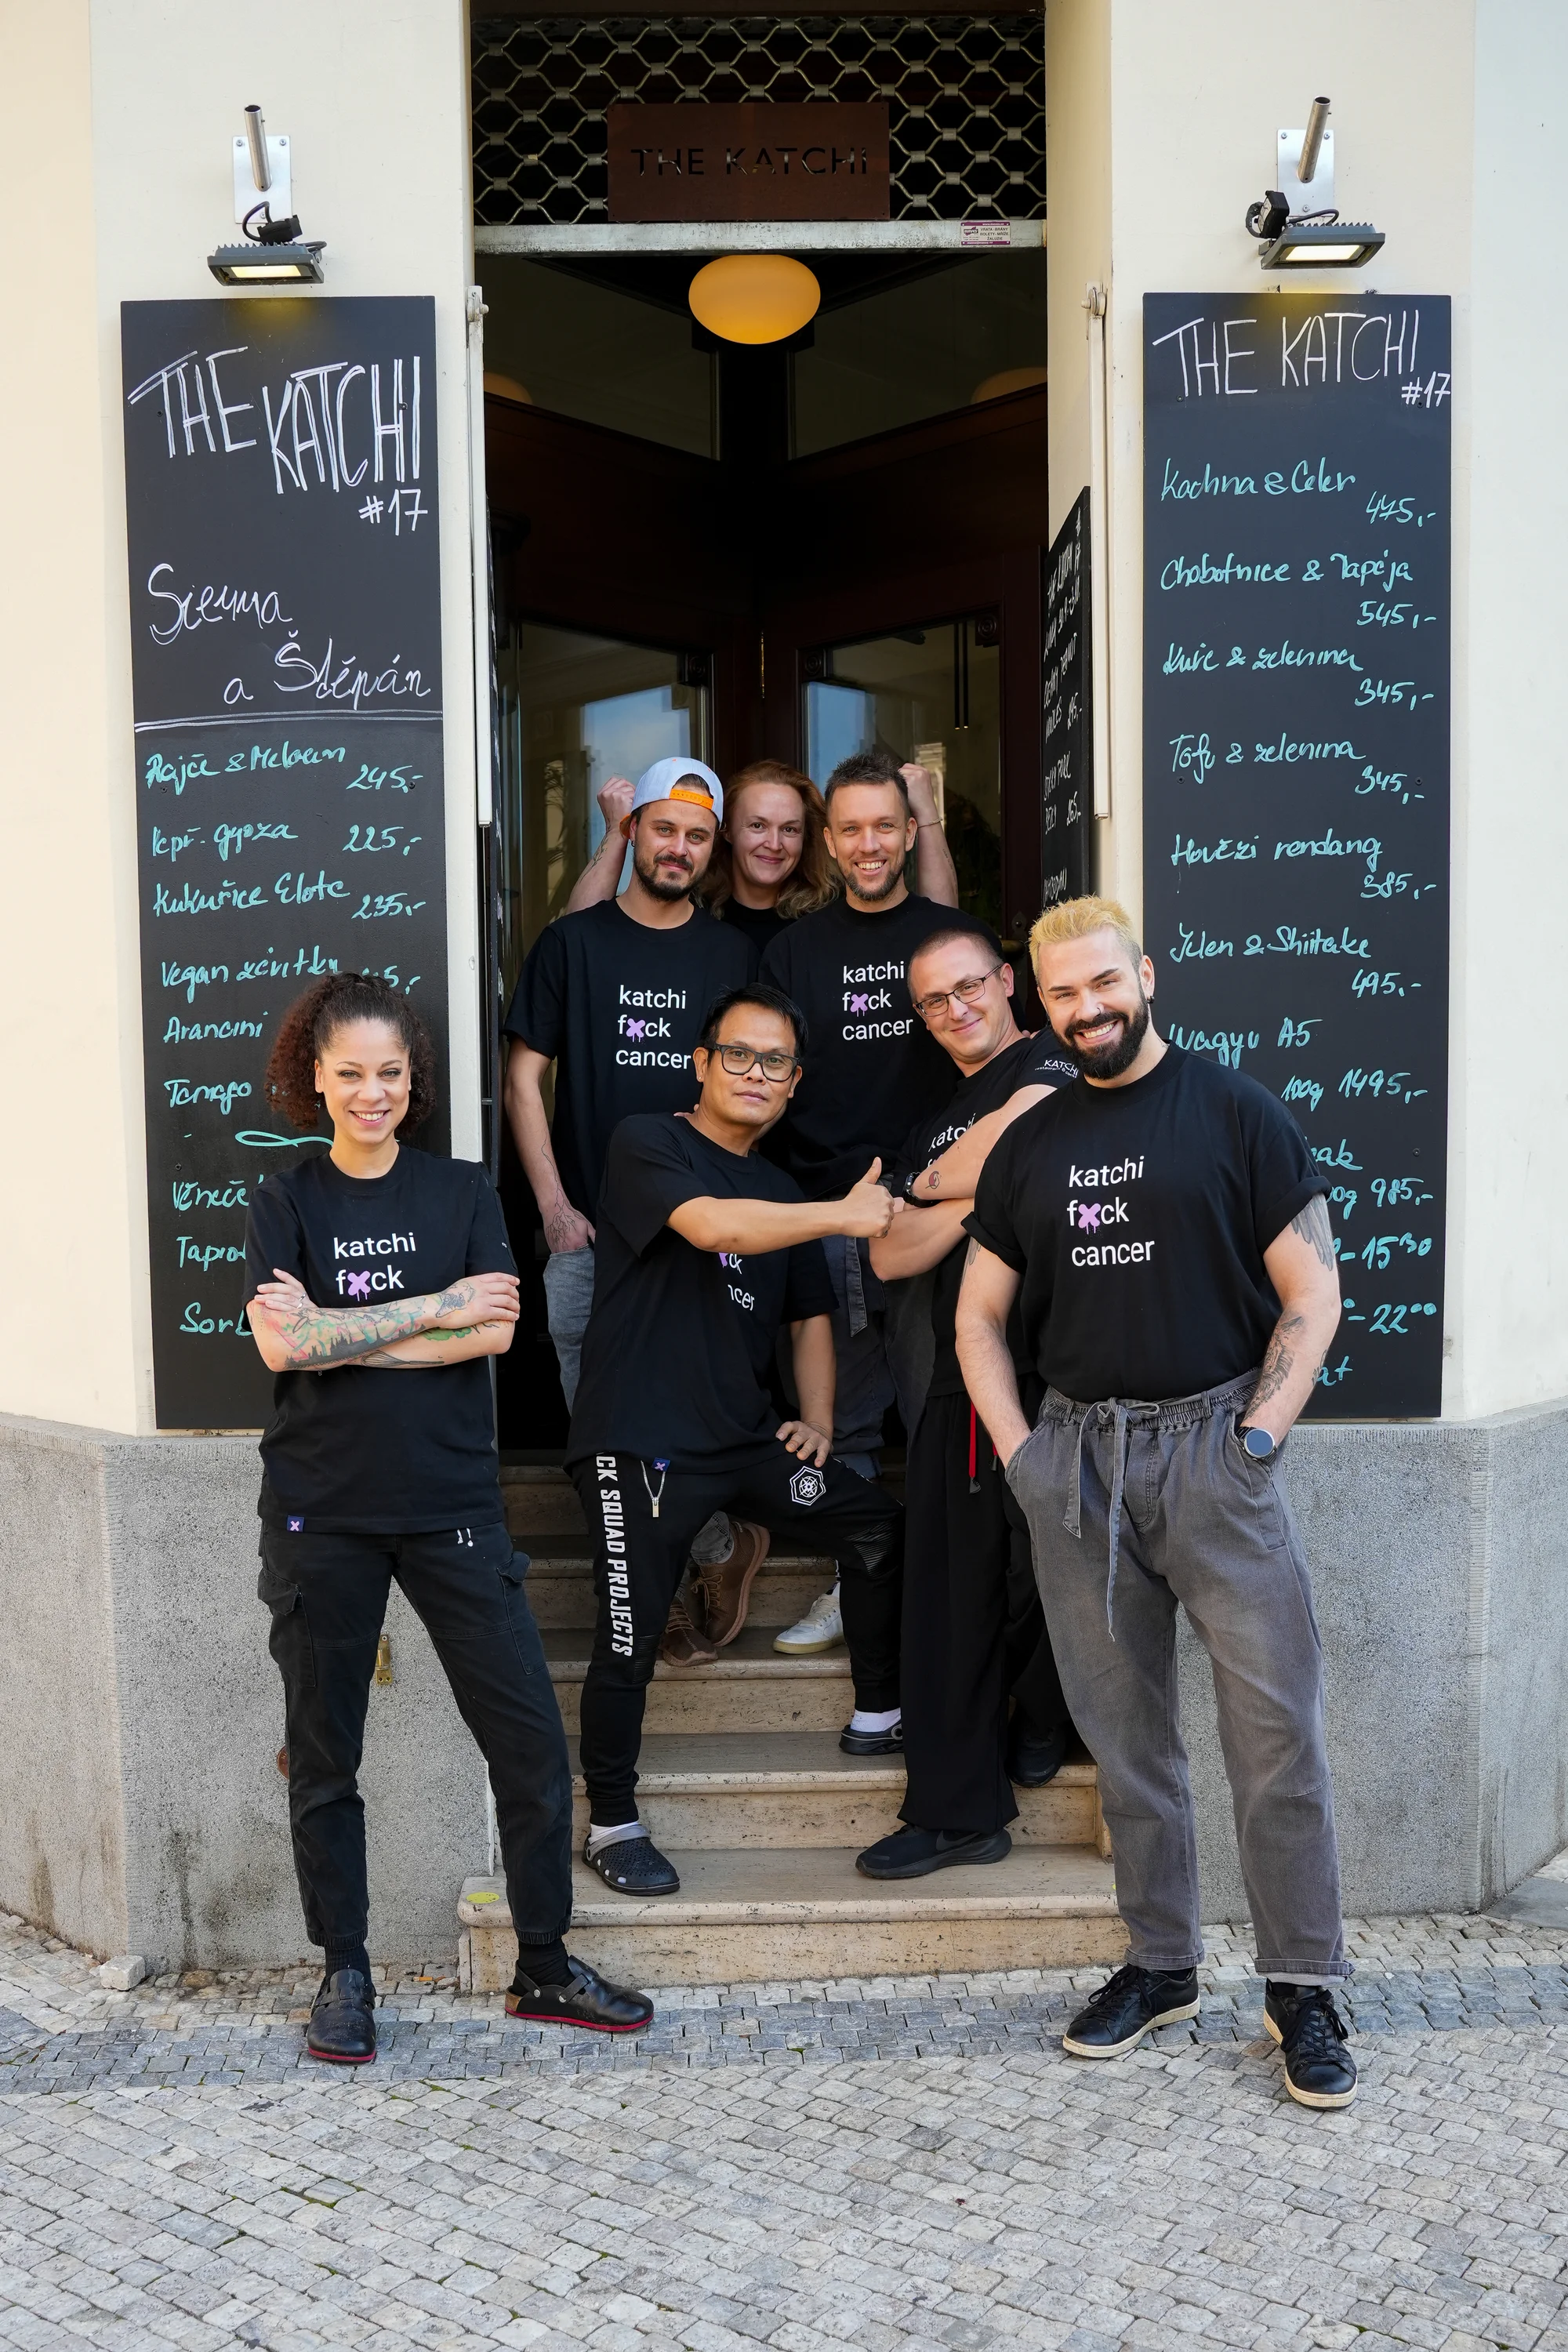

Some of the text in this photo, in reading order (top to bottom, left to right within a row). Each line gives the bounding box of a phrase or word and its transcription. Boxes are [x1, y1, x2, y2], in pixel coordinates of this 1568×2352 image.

[630, 147, 867, 176] THE KATCHI
[1152, 309, 1419, 397] THE KATCHI
[1401, 371, 1451, 408] #17
[127, 347, 421, 494] THE KATCHI
[1264, 472, 1288, 495] &
[358, 488, 429, 536] #17
[1160, 552, 1291, 590] Chobotnice
[1302, 559, 1325, 582] &
[1356, 601, 1437, 629] 545,-
[1225, 646, 1246, 667] &
[223, 677, 254, 704] a
[1354, 678, 1435, 710] 345,-
[224, 753, 248, 772] &
[1225, 743, 1244, 764] &
[345, 763, 424, 793] 245,-
[1354, 765, 1425, 804] 345,-
[342, 823, 423, 857] 225,-
[1274, 828, 1383, 873] rendang
[1360, 871, 1437, 900] 385,-
[351, 891, 427, 920] 235,-
[1243, 934, 1265, 958] &
[161, 961, 229, 1004] Vegan
[842, 960, 906, 985] katchi
[619, 985, 688, 1010] katchi
[162, 1011, 270, 1044] Arancini
[841, 1018, 914, 1041] cancer
[1168, 1016, 1323, 1070] Wagyu A5
[615, 1048, 692, 1070] cancer
[1044, 1058, 1080, 1076] KATCHI
[1338, 1068, 1428, 1104] 1495,-
[1069, 1155, 1145, 1188] katchi
[172, 1174, 265, 1211] Věneče
[1370, 1177, 1434, 1208] 985,-
[333, 1232, 417, 1260] katchi
[1071, 1240, 1156, 1267] cancer
[596, 1454, 633, 1657] CK SQUAD PROJECTS
